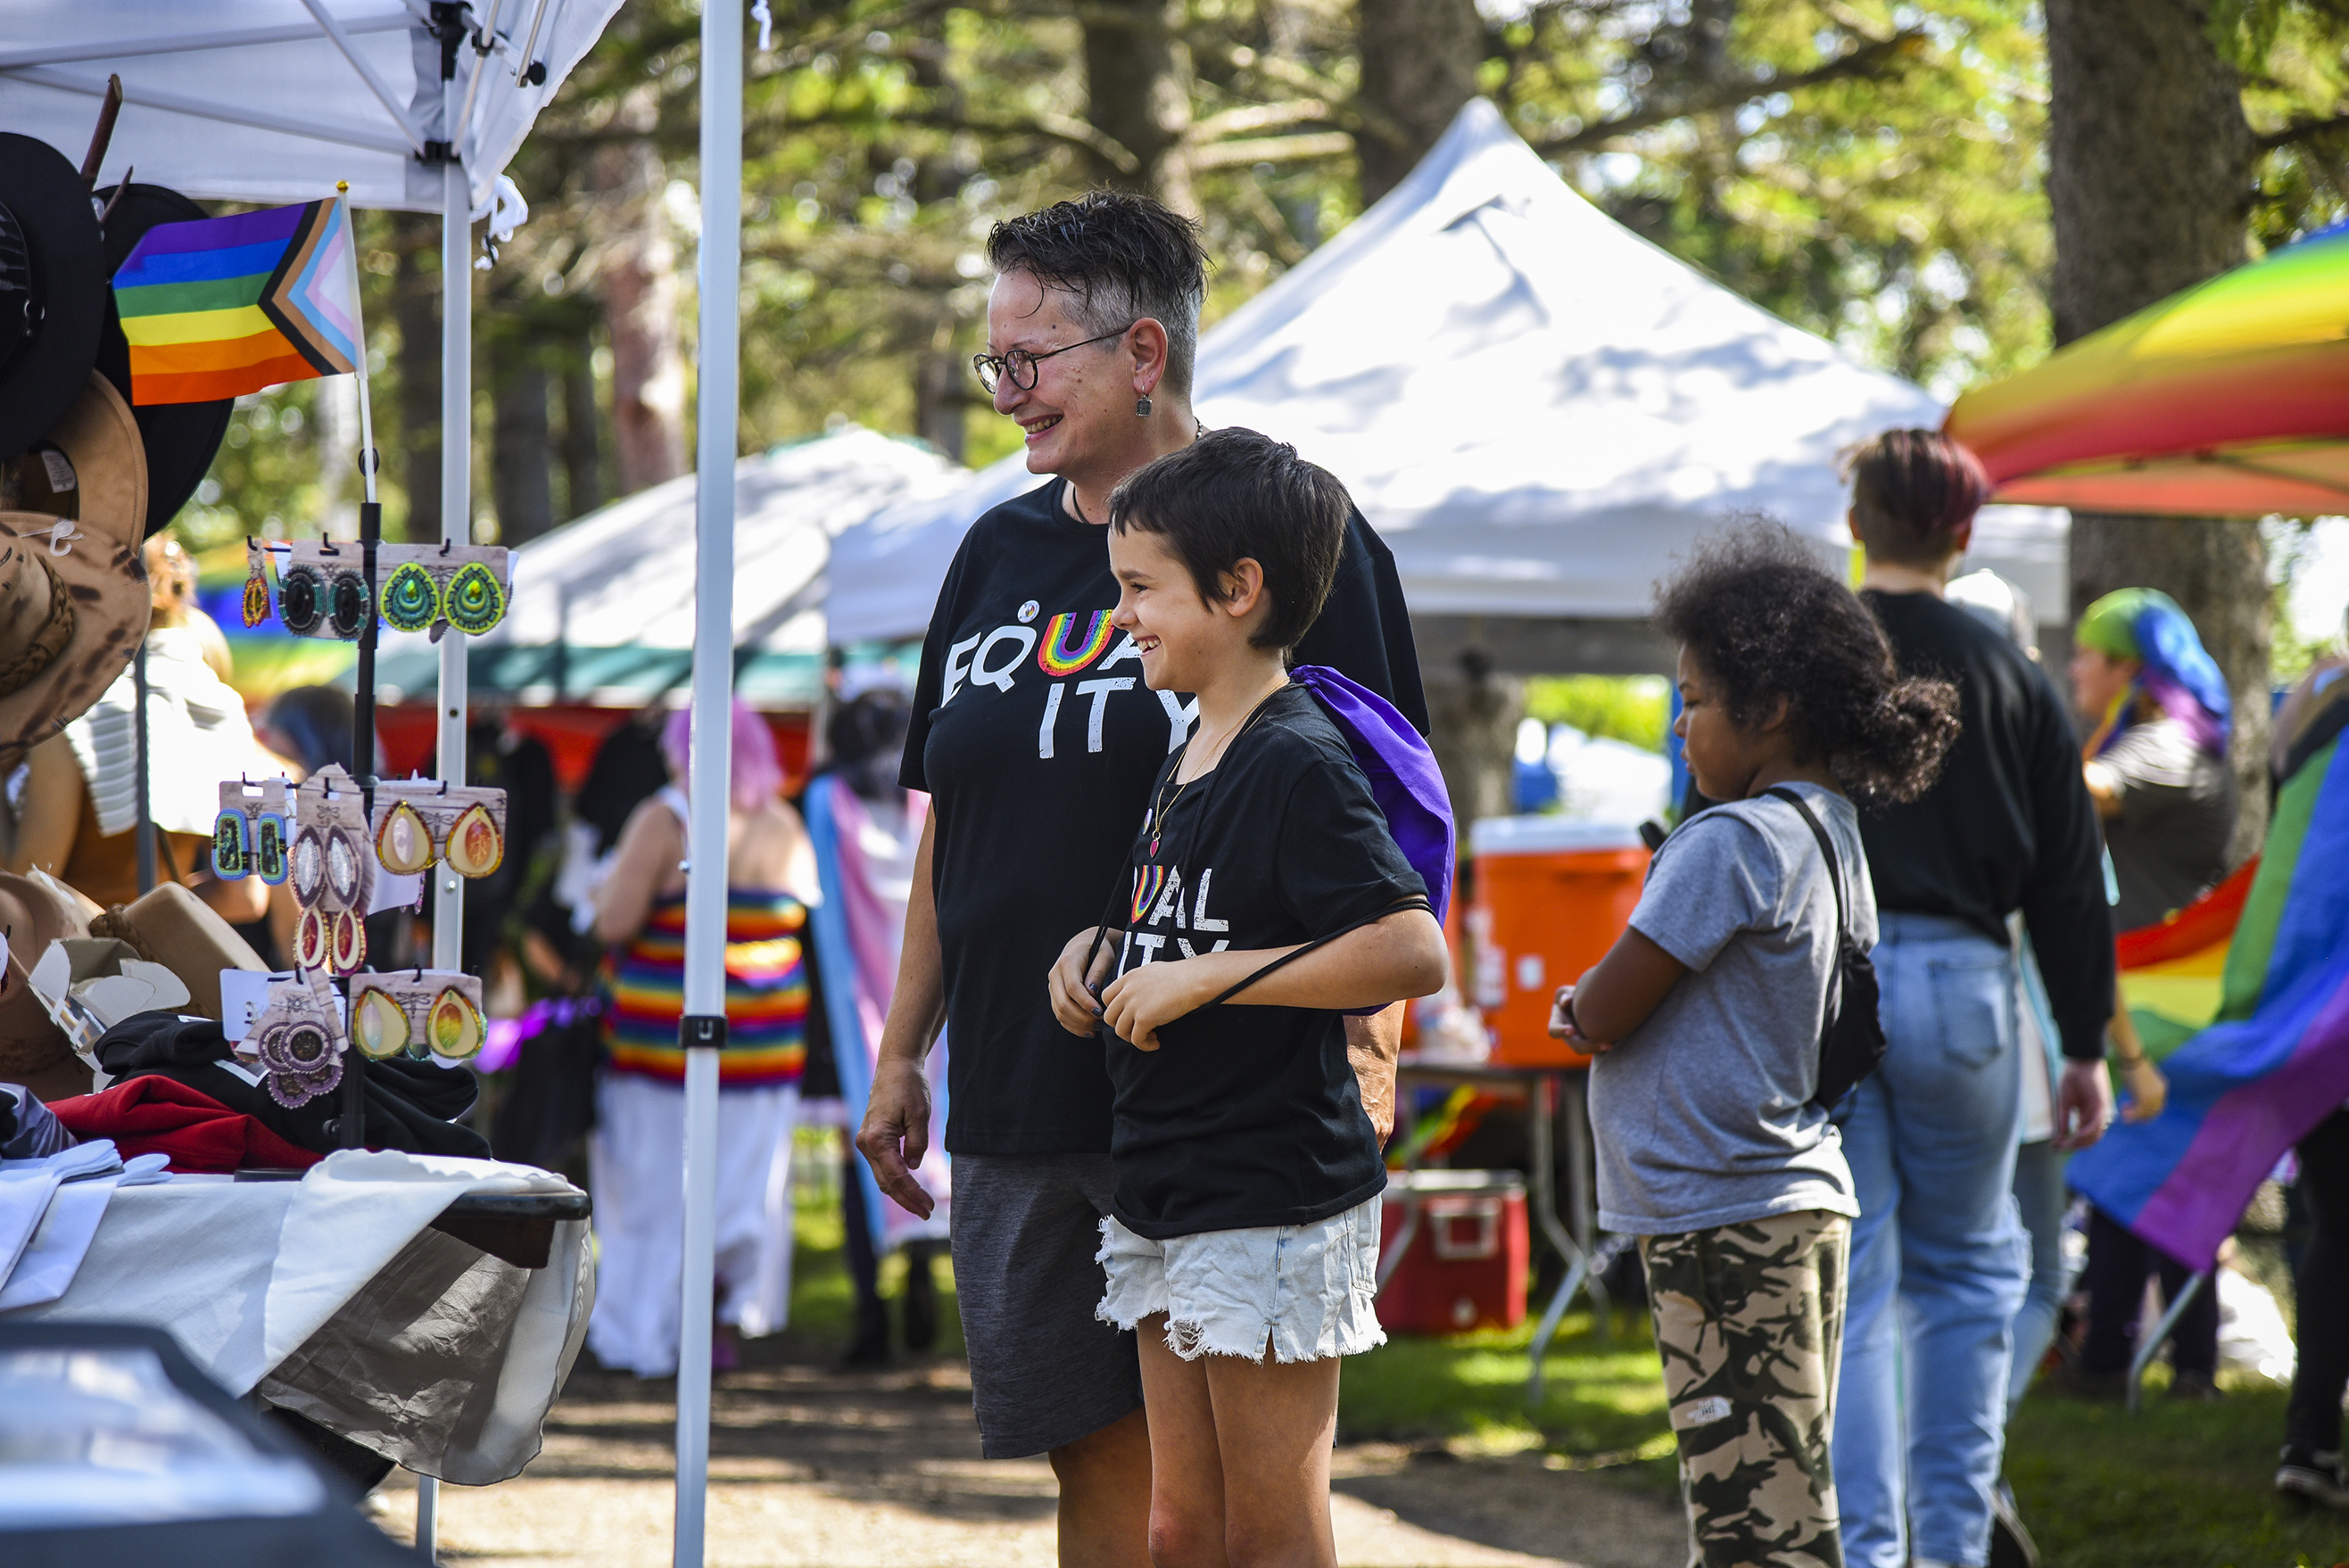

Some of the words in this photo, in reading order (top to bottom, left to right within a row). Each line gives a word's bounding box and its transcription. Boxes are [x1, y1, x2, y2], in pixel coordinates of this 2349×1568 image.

[941, 609, 1141, 708] EQUA
[1039, 677, 1200, 759] ITY
[1130, 865, 1229, 932] UAL
